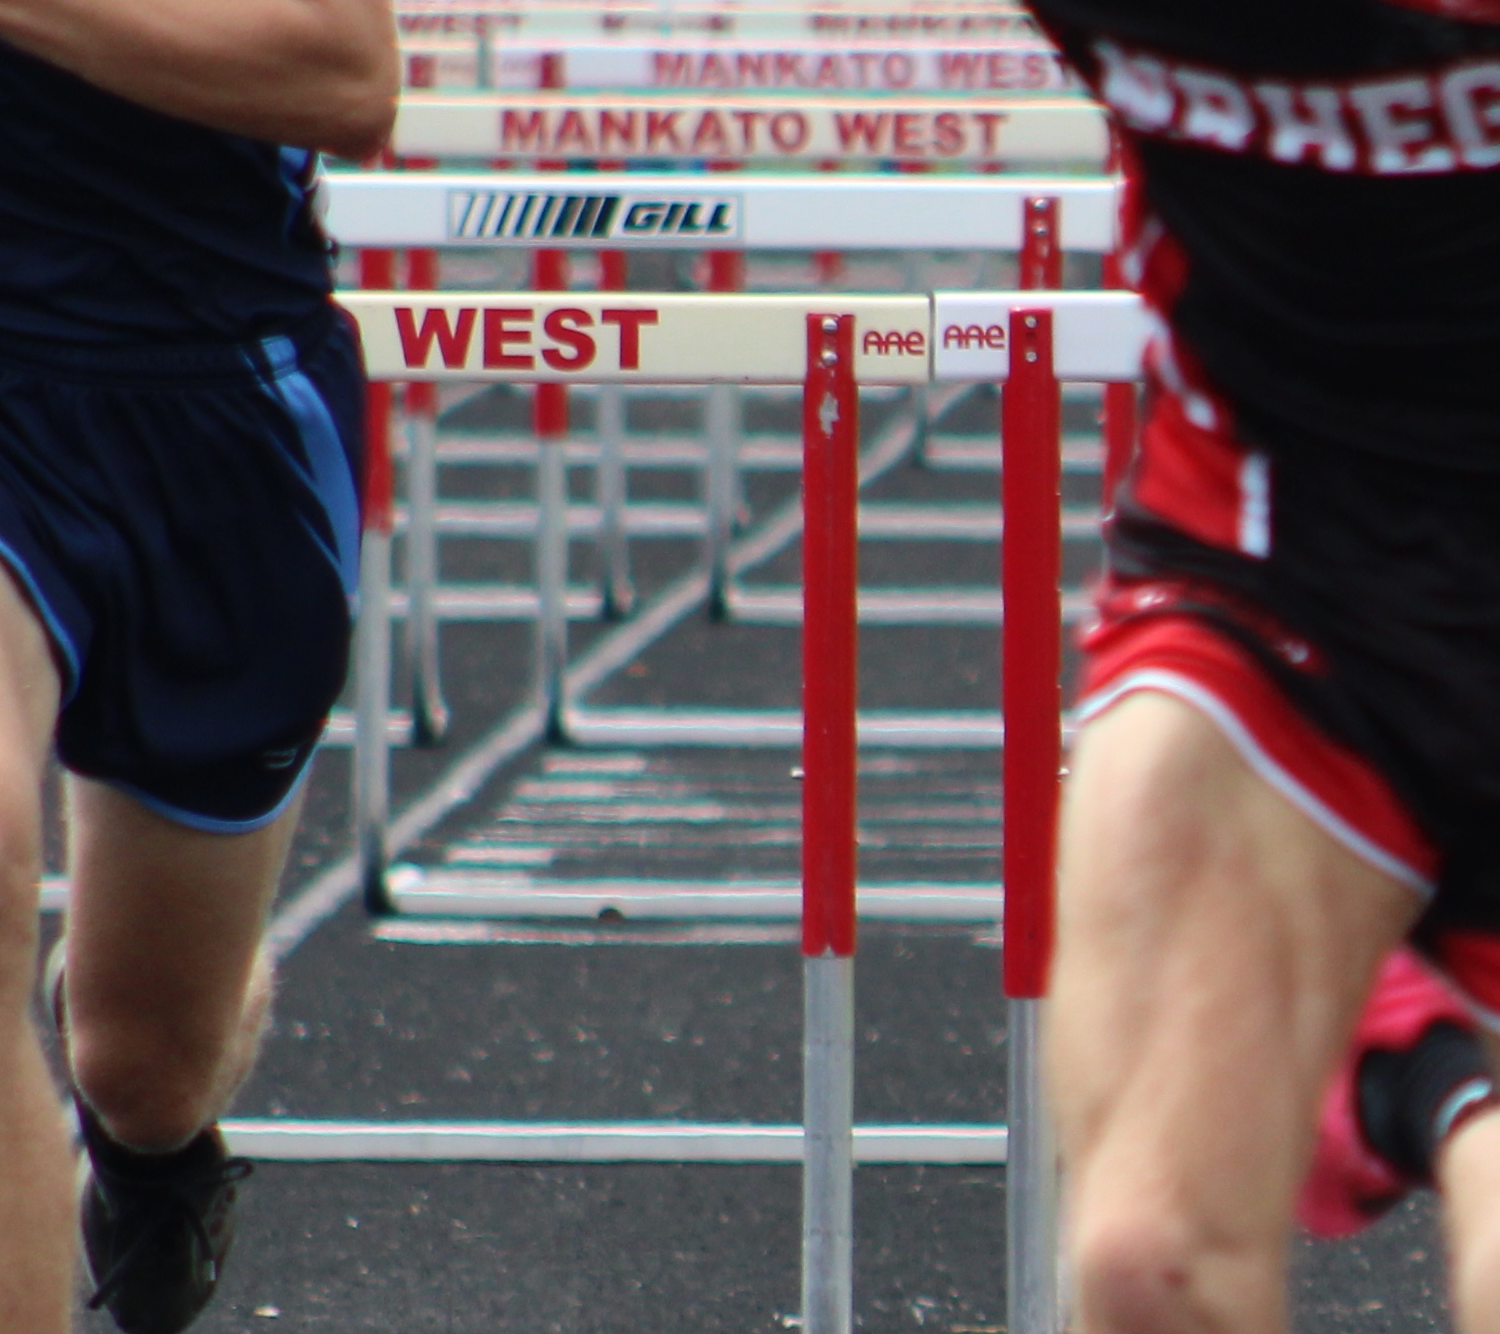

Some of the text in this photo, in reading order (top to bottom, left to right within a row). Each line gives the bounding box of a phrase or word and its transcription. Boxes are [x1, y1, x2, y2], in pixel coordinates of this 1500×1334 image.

[652, 52, 917, 90] MANKATO
[501, 109, 1008, 157] MANKATO WEST
[622, 201, 731, 234] GILL
[394, 306, 660, 371] WEST
